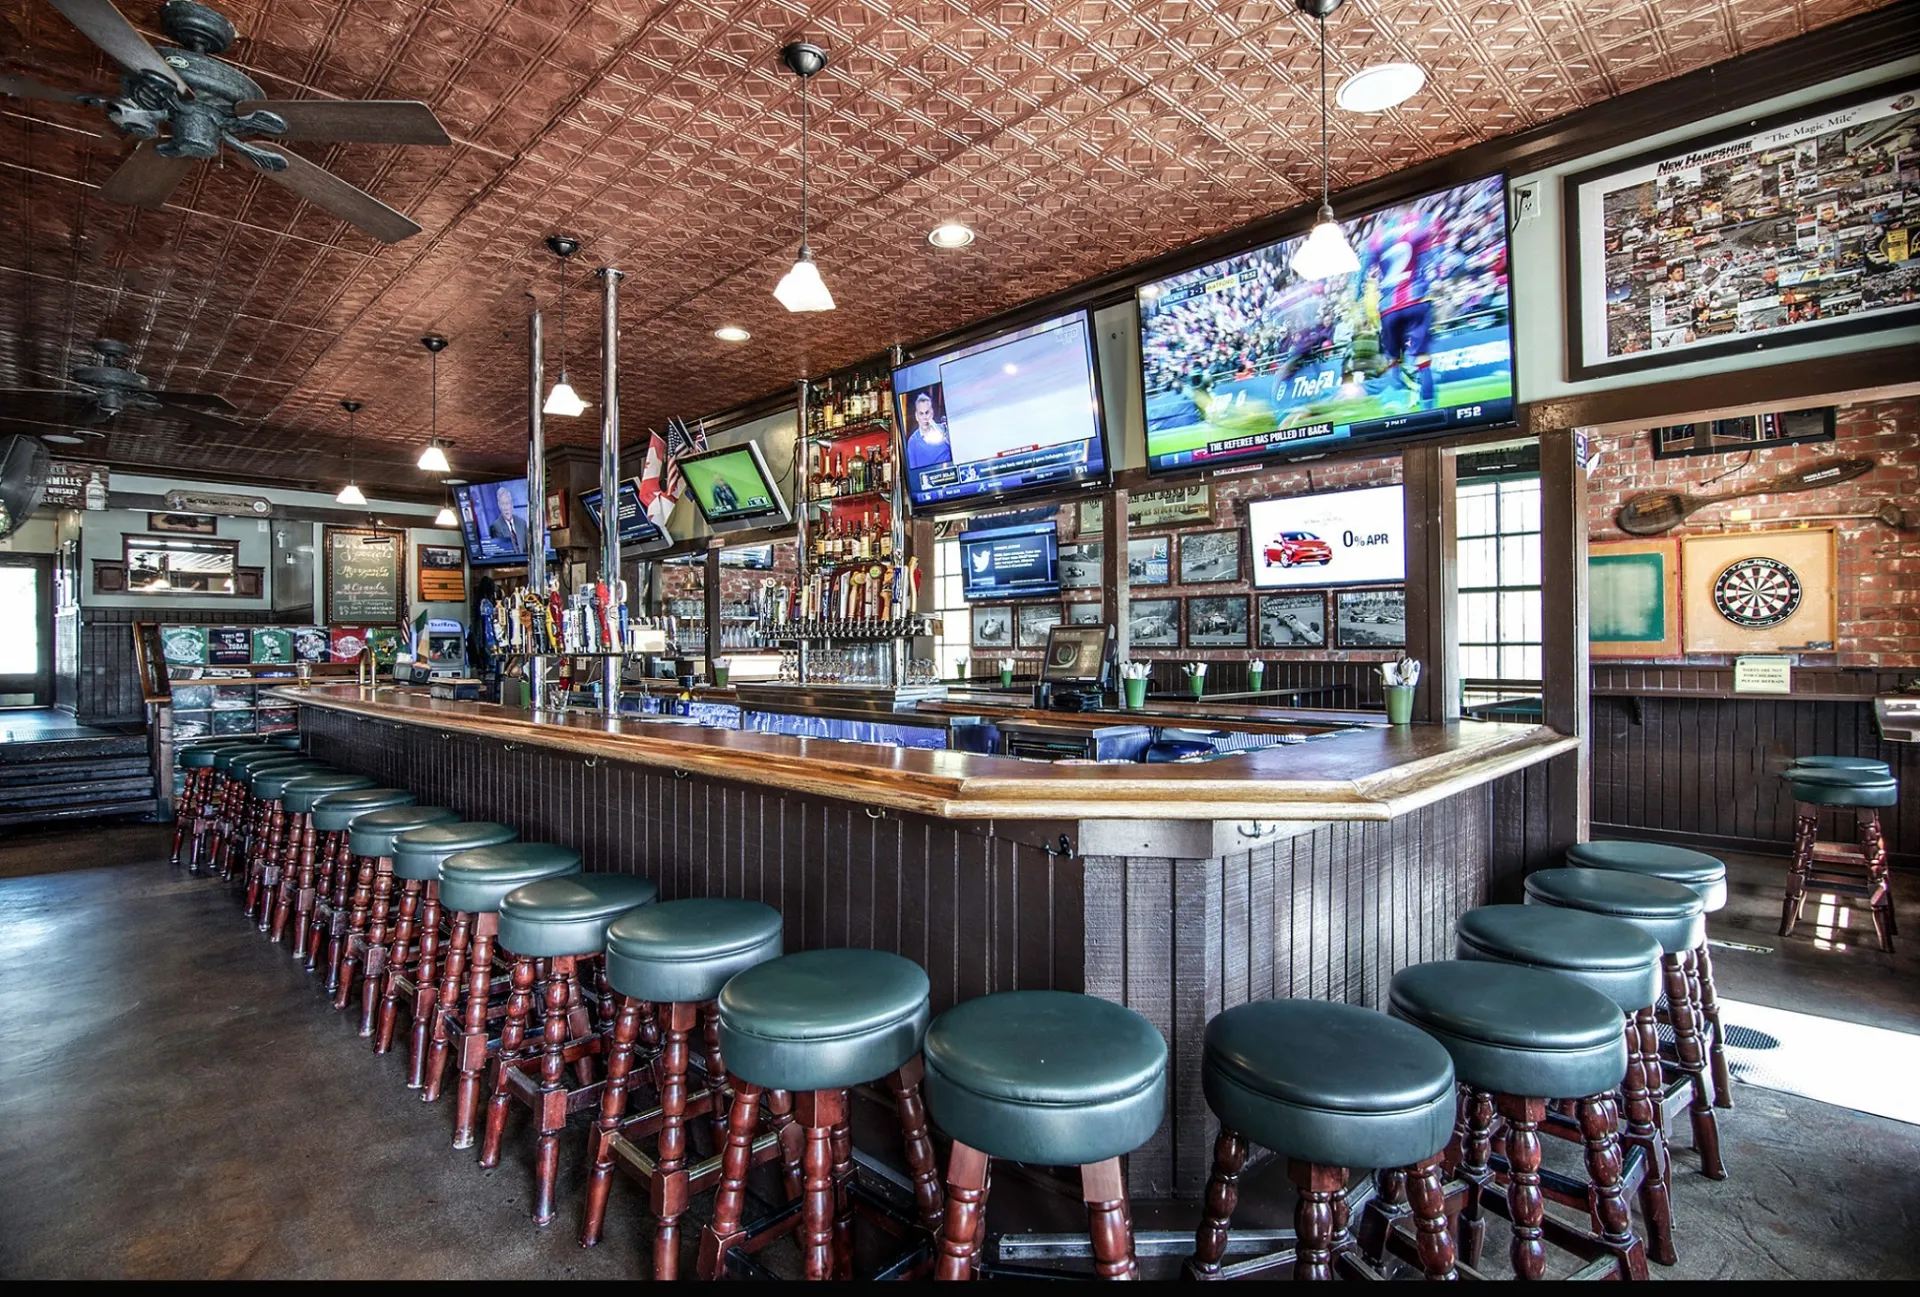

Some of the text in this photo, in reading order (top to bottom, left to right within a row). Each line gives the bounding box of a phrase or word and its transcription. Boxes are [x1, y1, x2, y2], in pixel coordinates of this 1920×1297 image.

[1794, 122, 1825, 137] Magic
[1379, 240, 1414, 289] 2
[1206, 277, 1235, 291] WATFORD
[1210, 424, 1331, 452] THE REFEREE HAS PULLED IT BACK.
[1343, 530, 1389, 548] 0% APR
